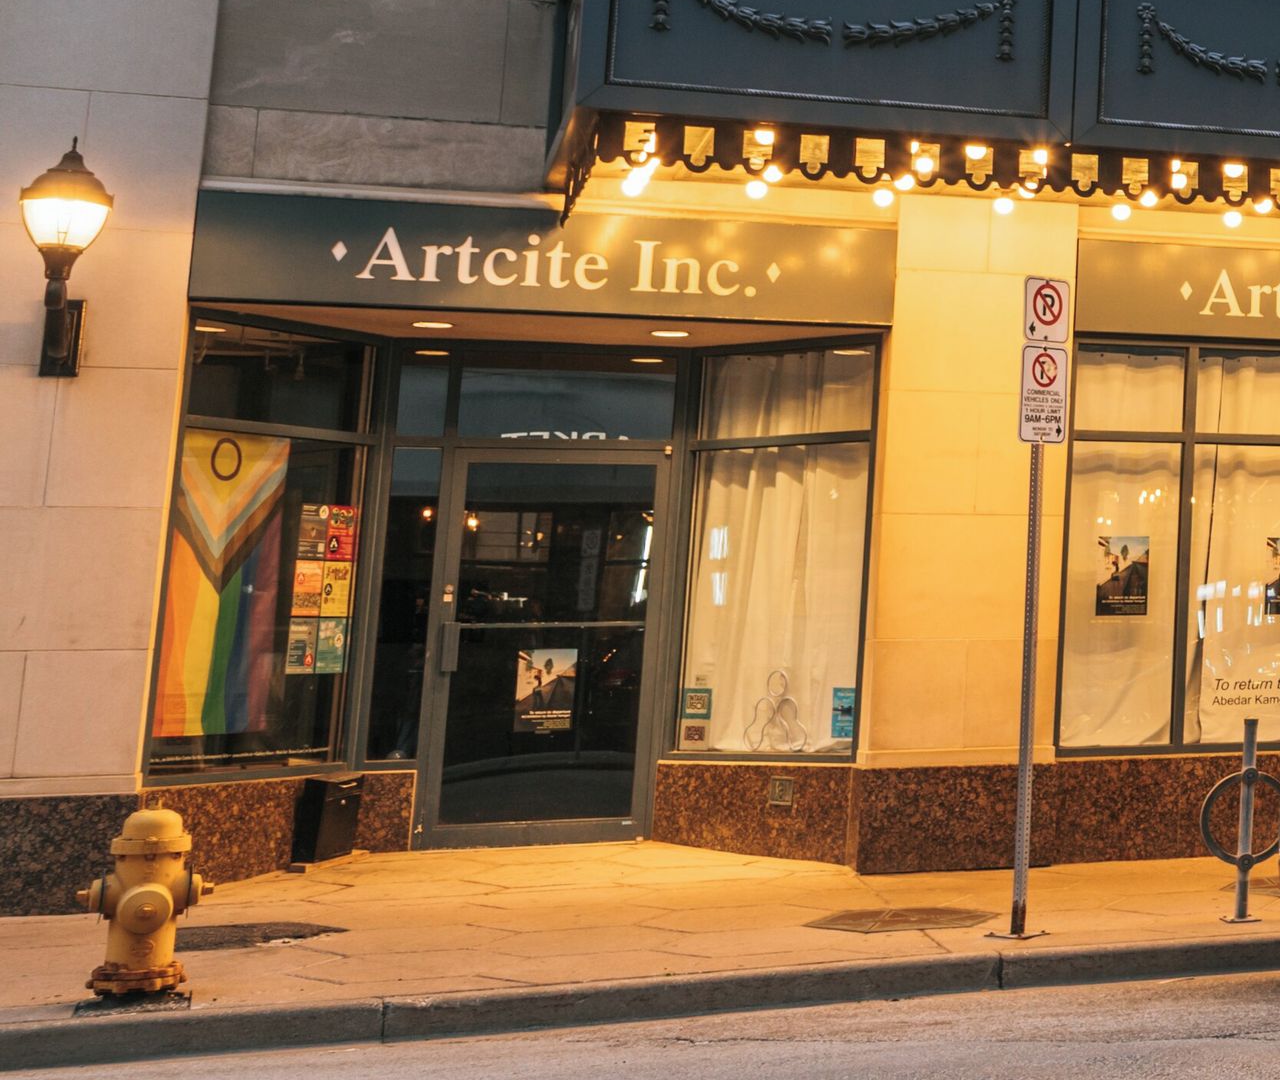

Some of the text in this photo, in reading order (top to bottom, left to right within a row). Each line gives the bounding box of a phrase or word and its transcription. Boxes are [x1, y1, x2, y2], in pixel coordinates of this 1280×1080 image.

[355, 226, 757, 298] Artcite Inc.
[1024, 414, 1062, 424] 9AM-6PM
[1214, 678, 1229, 691] To
[1233, 678, 1273, 691] return
[1212, 695, 1251, 706] Abedar
